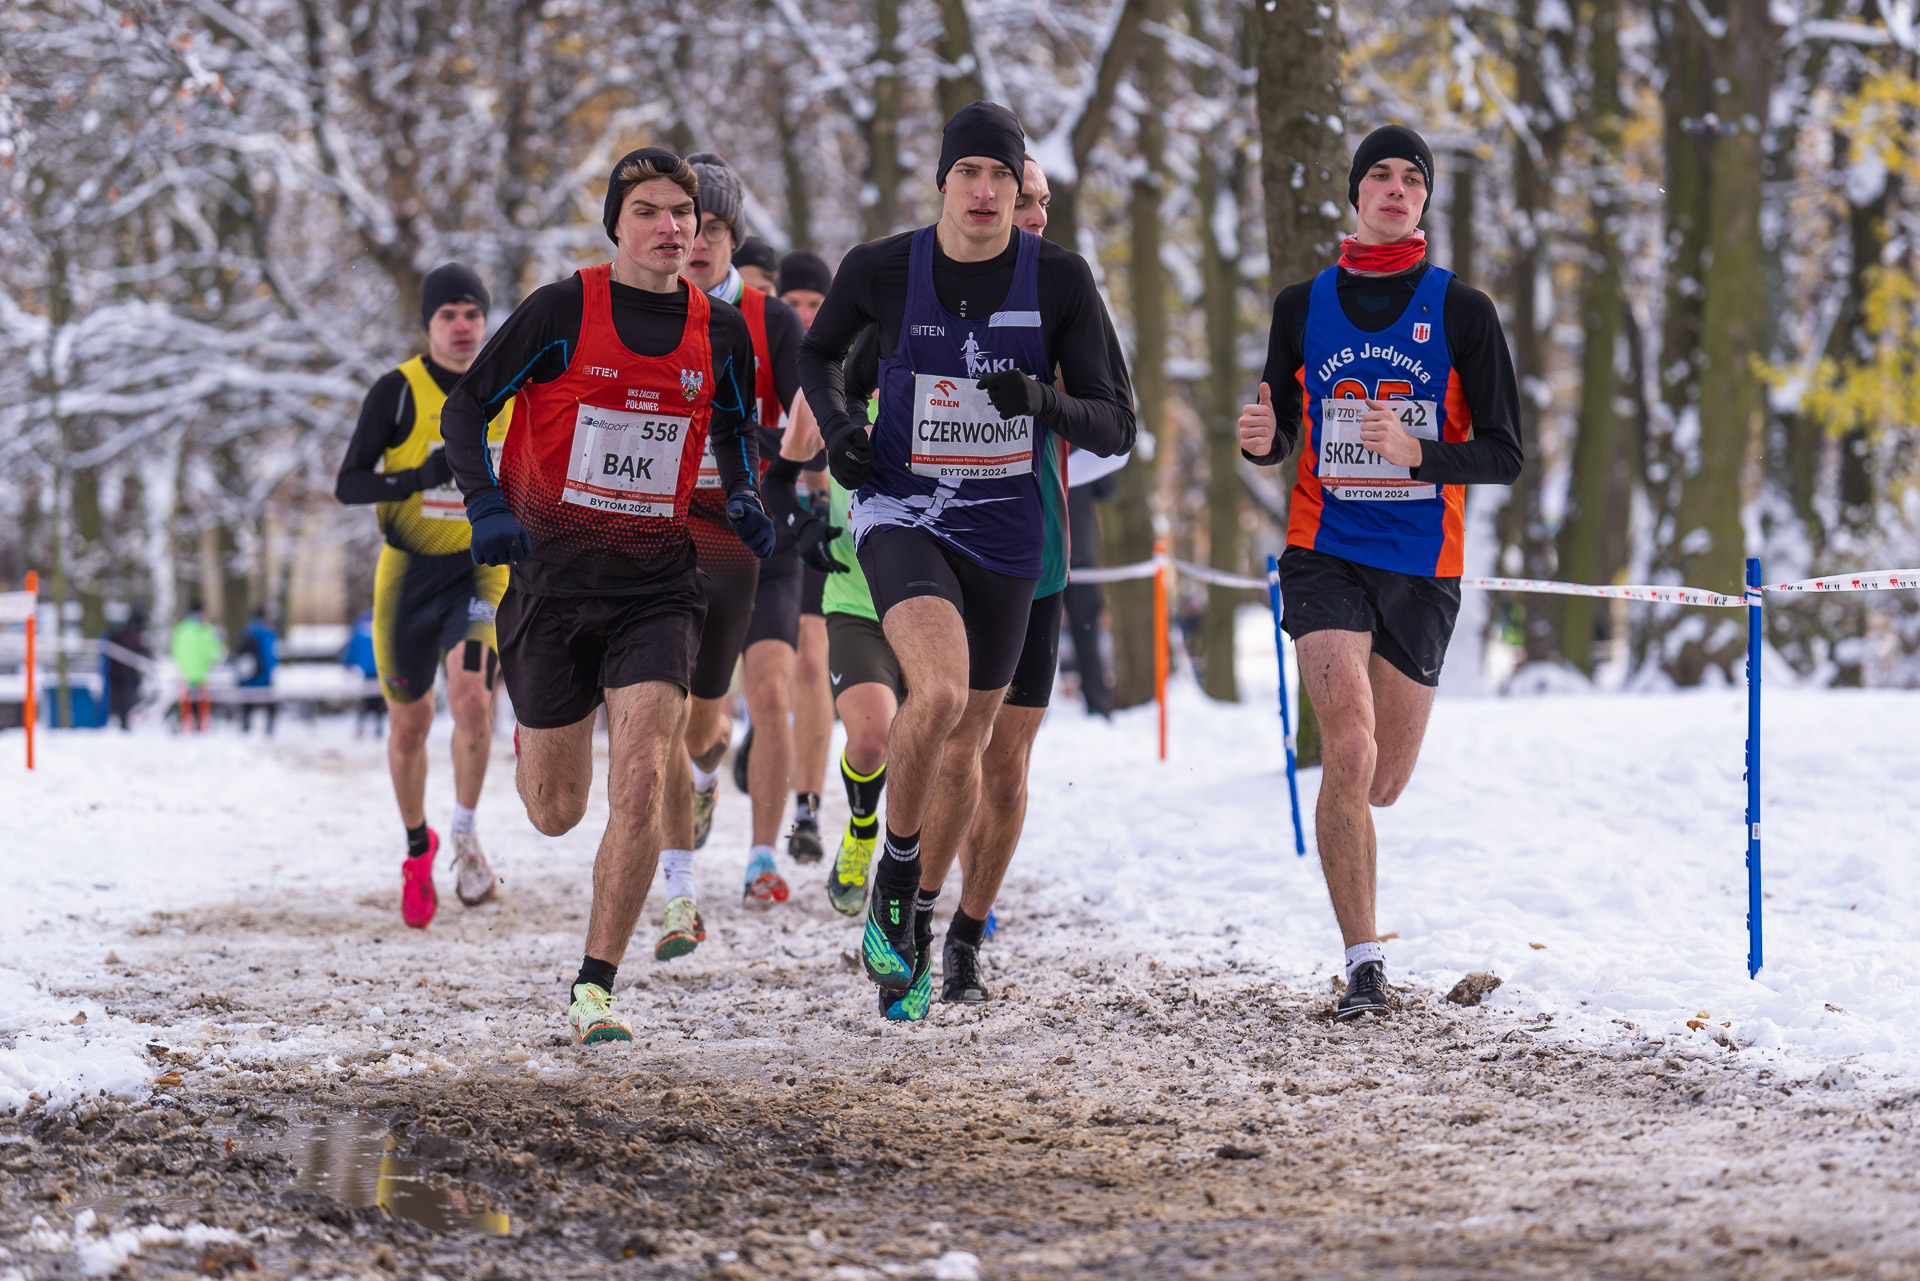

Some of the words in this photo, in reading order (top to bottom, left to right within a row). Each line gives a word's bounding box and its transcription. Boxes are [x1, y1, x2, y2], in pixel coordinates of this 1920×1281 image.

[1318, 347, 1355, 382] UKS
[1360, 342, 1431, 384] Jedynka
[627, 388, 639, 397] UKS
[625, 399, 659, 411] POŁANIEC
[930, 398, 960, 408] ORLEN
[1337, 407, 1355, 418] 770
[1391, 407, 1428, 427] 42
[585, 416, 629, 431] Bellsport
[917, 417, 1029, 444] CZERWONKA
[640, 421, 679, 443] 558
[602, 452, 655, 483] BĄK
[940, 468, 980, 477] BYTOM
[982, 467, 1007, 477] 2024
[1345, 490, 1382, 498] BYTOM
[1384, 490, 1410, 498] 2024
[590, 497, 627, 511] BYTOM
[628, 503, 652, 514] 2024
